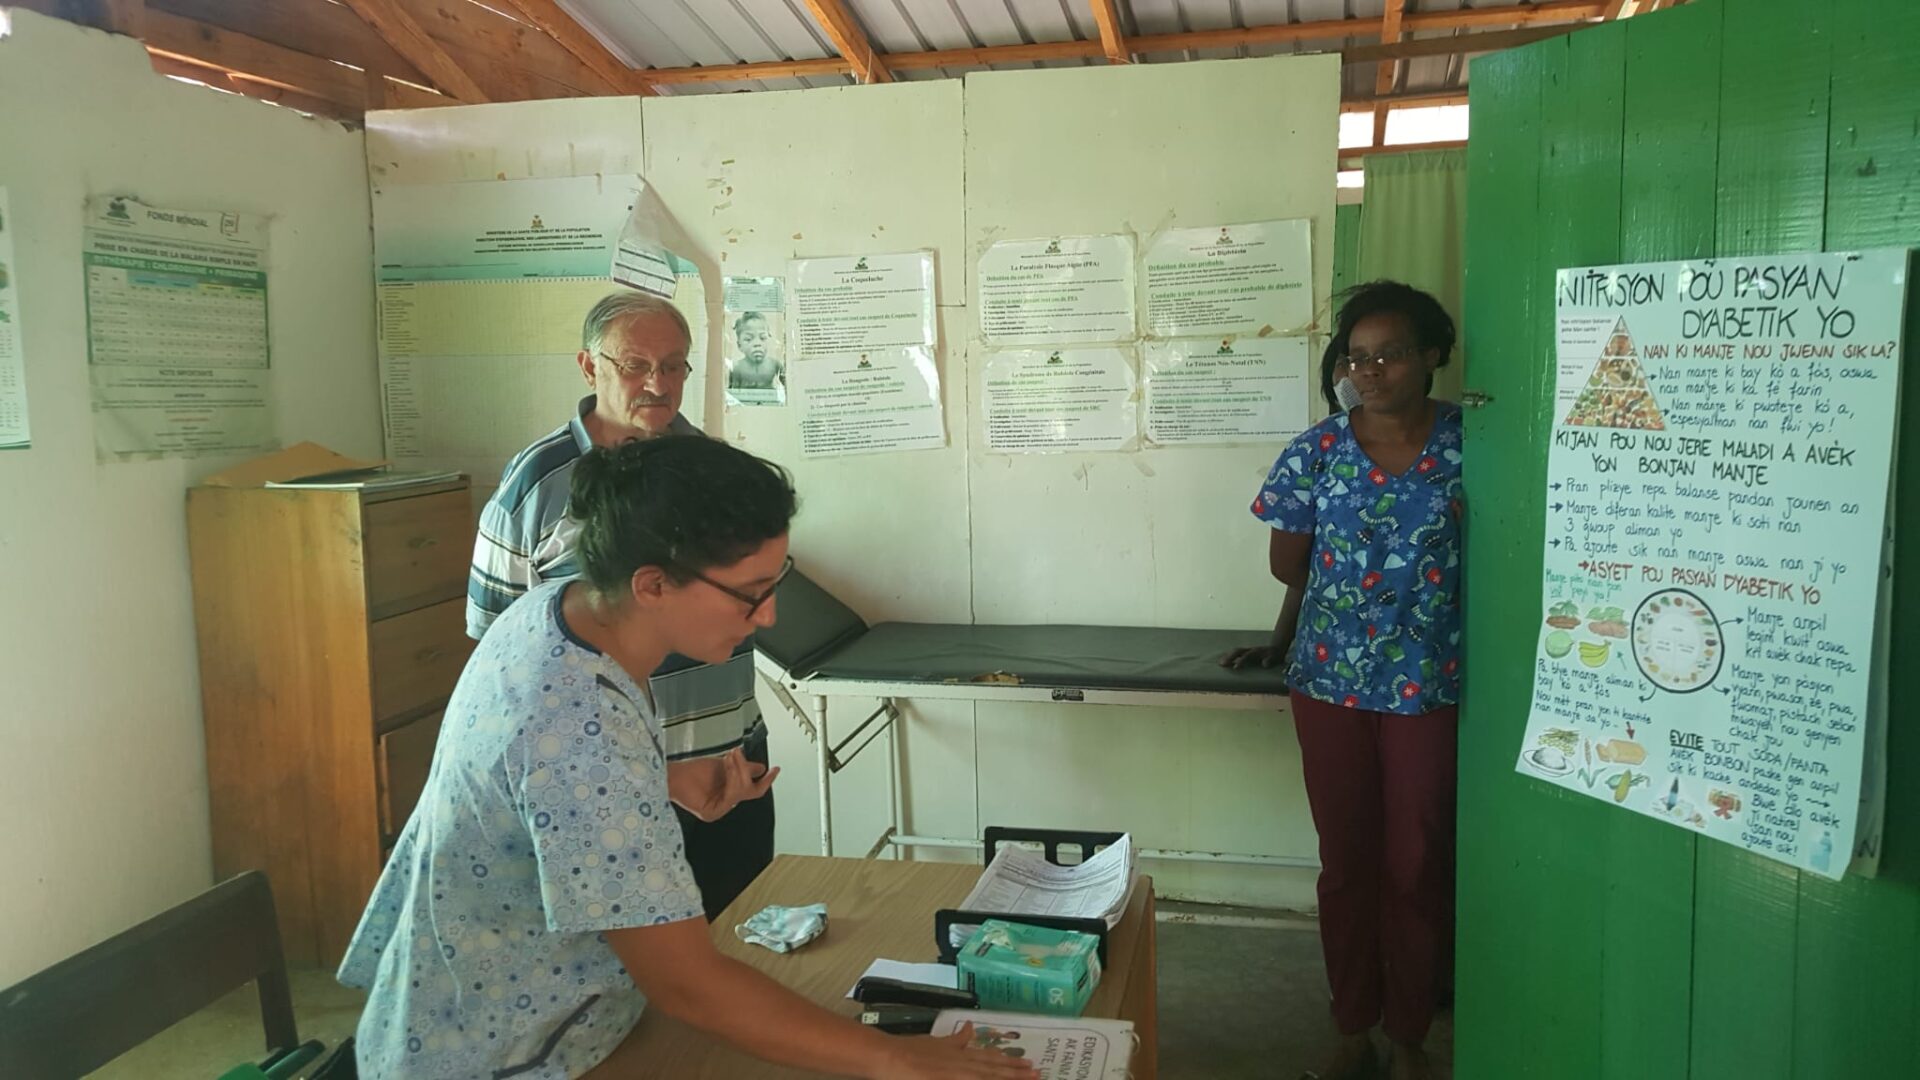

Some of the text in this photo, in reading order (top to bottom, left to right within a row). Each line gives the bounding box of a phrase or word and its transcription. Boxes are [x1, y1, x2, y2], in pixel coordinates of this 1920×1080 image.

[1734, 264, 1844, 301] PASYAN
[1682, 305, 1855, 340] DYABETIK YO
[1643, 341, 1897, 361] NAN KI MANJE NOU JWENN SIK LA?
[1659, 367, 1681, 380] Nan
[1686, 368, 1719, 385] manje
[1740, 365, 1762, 384] bay
[1789, 368, 1800, 378] a
[1839, 369, 1878, 380] aswa
[1659, 384, 1679, 395] nan
[1685, 383, 1719, 400] manje
[1789, 381, 1823, 400] farin
[1671, 399, 1690, 411] Nan
[1695, 400, 1726, 418] manje
[1748, 418, 1768, 429] nan
[1556, 430, 1598, 451] KIJAN
[1610, 431, 1636, 451] POU
[1644, 435, 1672, 451] NOU
[1678, 437, 1712, 458] JERE
[1722, 440, 1774, 461] MALADI
[1781, 442, 1796, 463] A
[1592, 453, 1769, 487] YON BONJAN MANJE
[1565, 477, 1589, 493] Pran
[1641, 484, 1667, 502] repa
[1675, 484, 1721, 501] balanse
[1728, 490, 1775, 511] pandan
[1782, 496, 1832, 519] jounen
[1839, 501, 1859, 515] an
[1565, 499, 1599, 521] Manje
[1605, 502, 1642, 519] diferan
[1646, 502, 1676, 521] kalite
[1684, 509, 1722, 534] manje
[1777, 518, 1801, 534] nan
[1564, 517, 1683, 548] 3 gwoup aliman yo
[1583, 540, 1618, 562] ajoute
[1628, 541, 1648, 557] sik
[1657, 545, 1680, 559] nan
[1687, 549, 1725, 573] manje
[1735, 554, 1769, 570] aswa
[1779, 554, 1804, 572] nan
[1830, 561, 1847, 585] yo
[1588, 561, 1633, 581] ASYET
[1671, 566, 1717, 589] PASYAN
[1723, 573, 1793, 602] DYABETIK
[1801, 585, 1821, 605] YO
[1747, 605, 1785, 634] Manje
[1731, 663, 1766, 688] Manje
[1825, 656, 1857, 678] repa
[1669, 729, 1741, 754] EVITE TOUT
[1704, 752, 1750, 774] BONBON
[1064, 1038, 1077, 1050] AK
